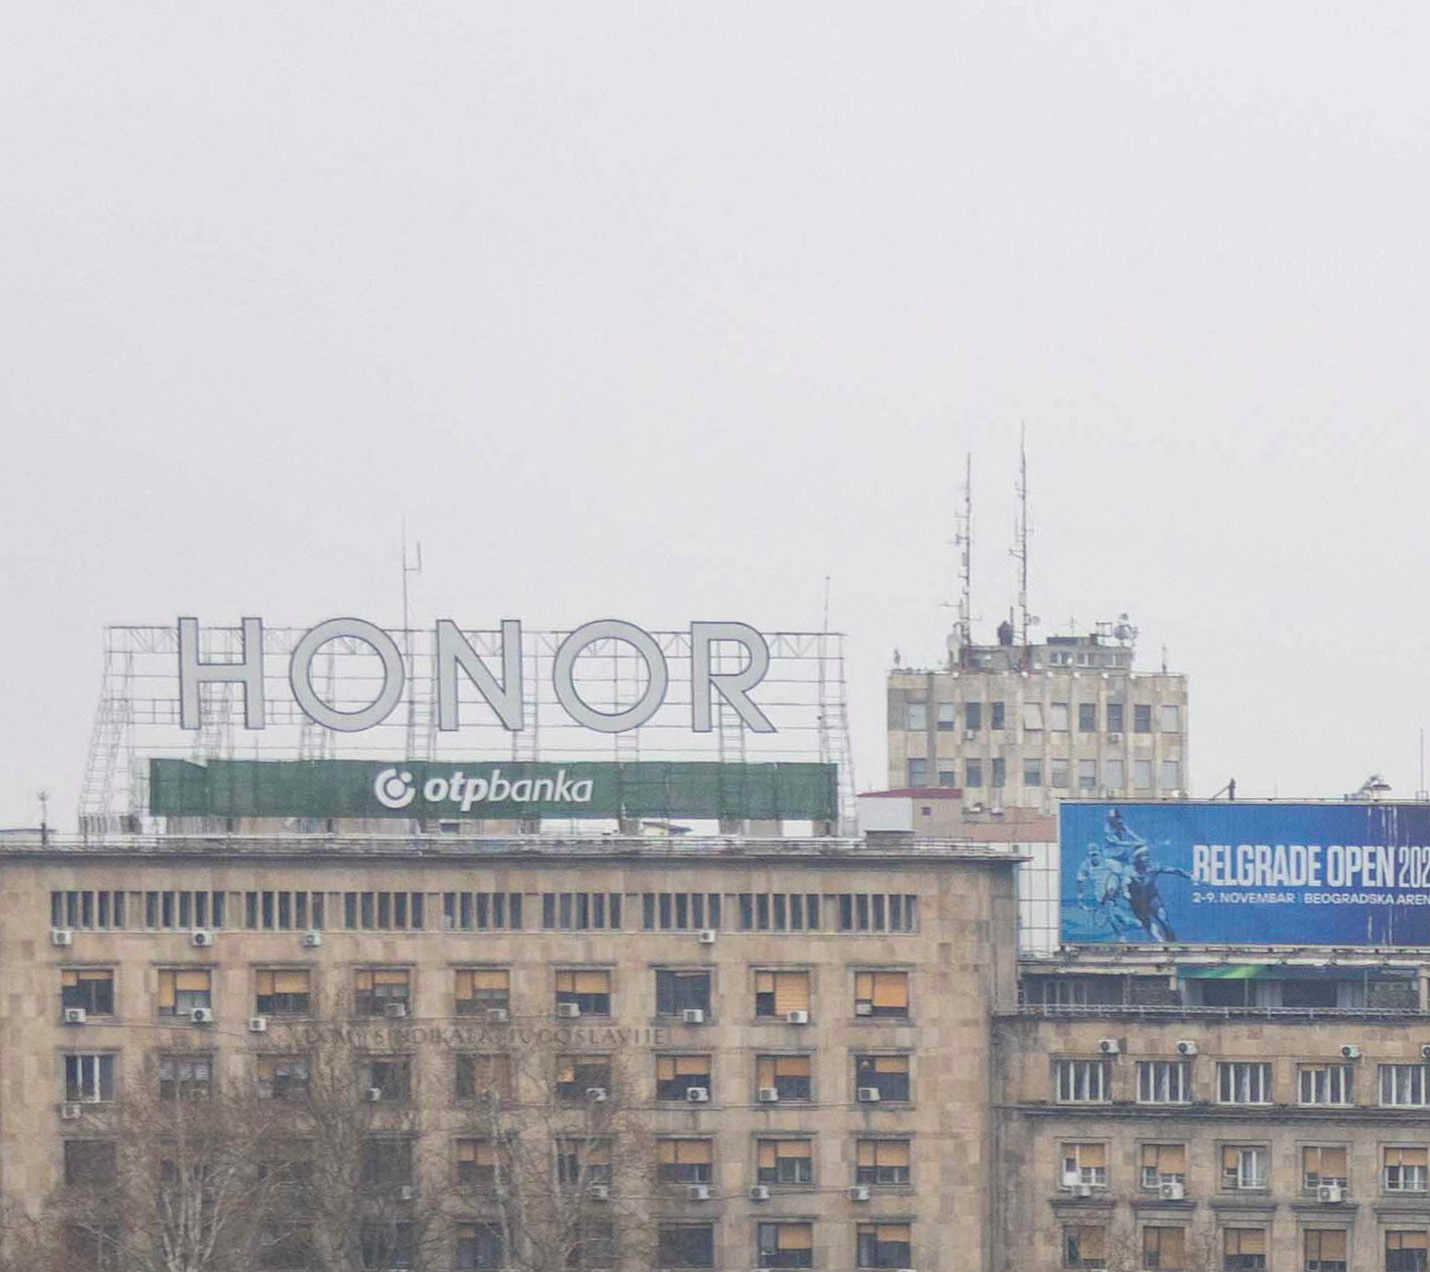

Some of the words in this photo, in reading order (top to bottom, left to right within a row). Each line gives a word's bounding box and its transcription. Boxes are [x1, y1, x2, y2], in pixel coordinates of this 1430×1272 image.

[178, 617, 777, 733] HONOR
[423, 769, 594, 811] otpbanka
[1193, 845, 1321, 887] BELGRADE
[1326, 846, 1395, 887] OPEN
[1220, 893, 1295, 904] NOVEMBAR
[1304, 893, 1395, 905] BEOGRADSKA
